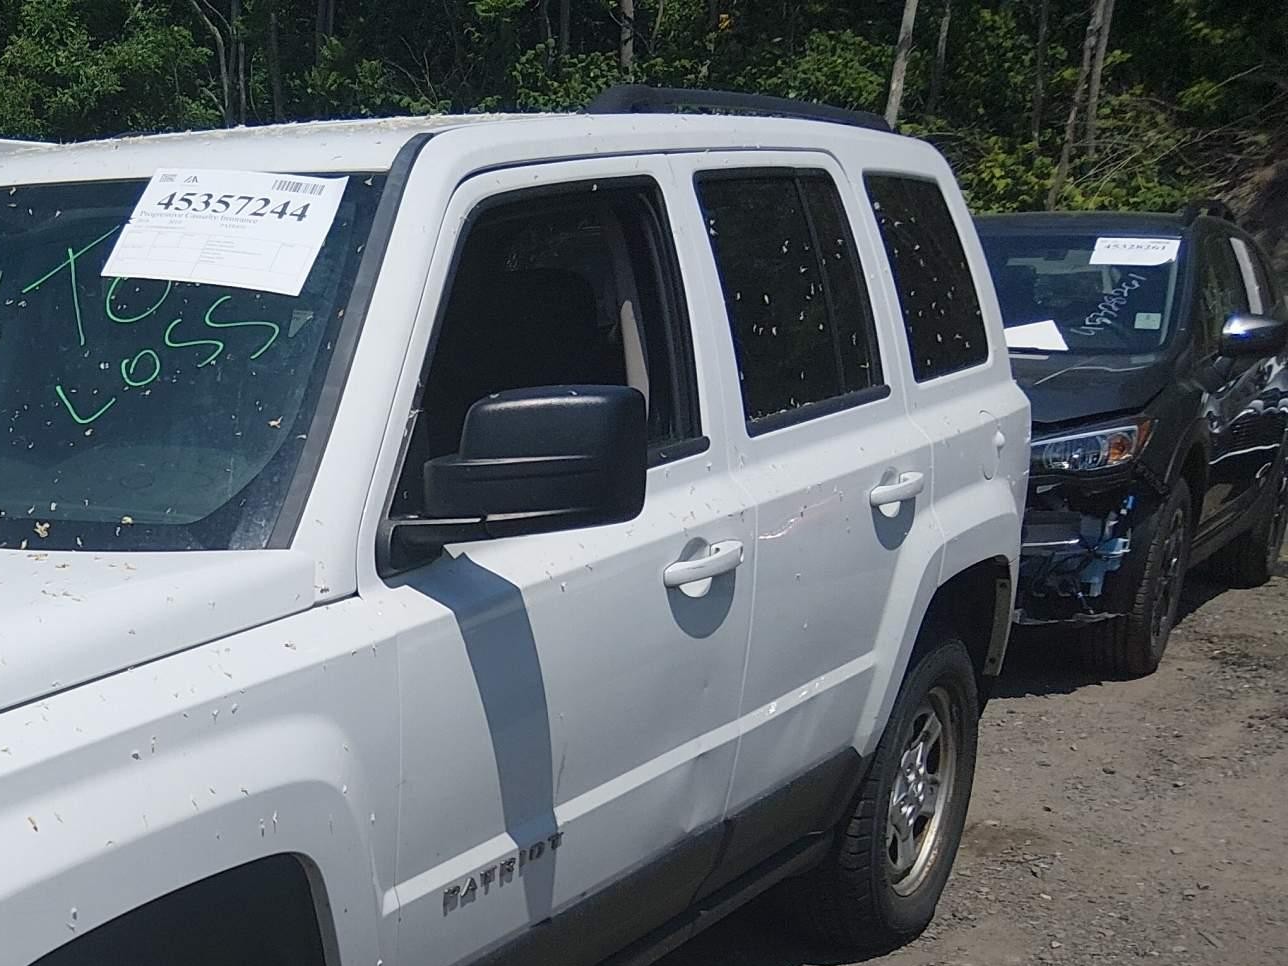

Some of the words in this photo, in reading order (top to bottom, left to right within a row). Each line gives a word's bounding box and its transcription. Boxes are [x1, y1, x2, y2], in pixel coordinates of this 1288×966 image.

[139, 210, 184, 219] Progressive
[185, 212, 217, 221] Casualty
[220, 215, 259, 224] Insurance
[157, 191, 311, 222] 45357244
[442, 831, 564, 910] PATRIOT
